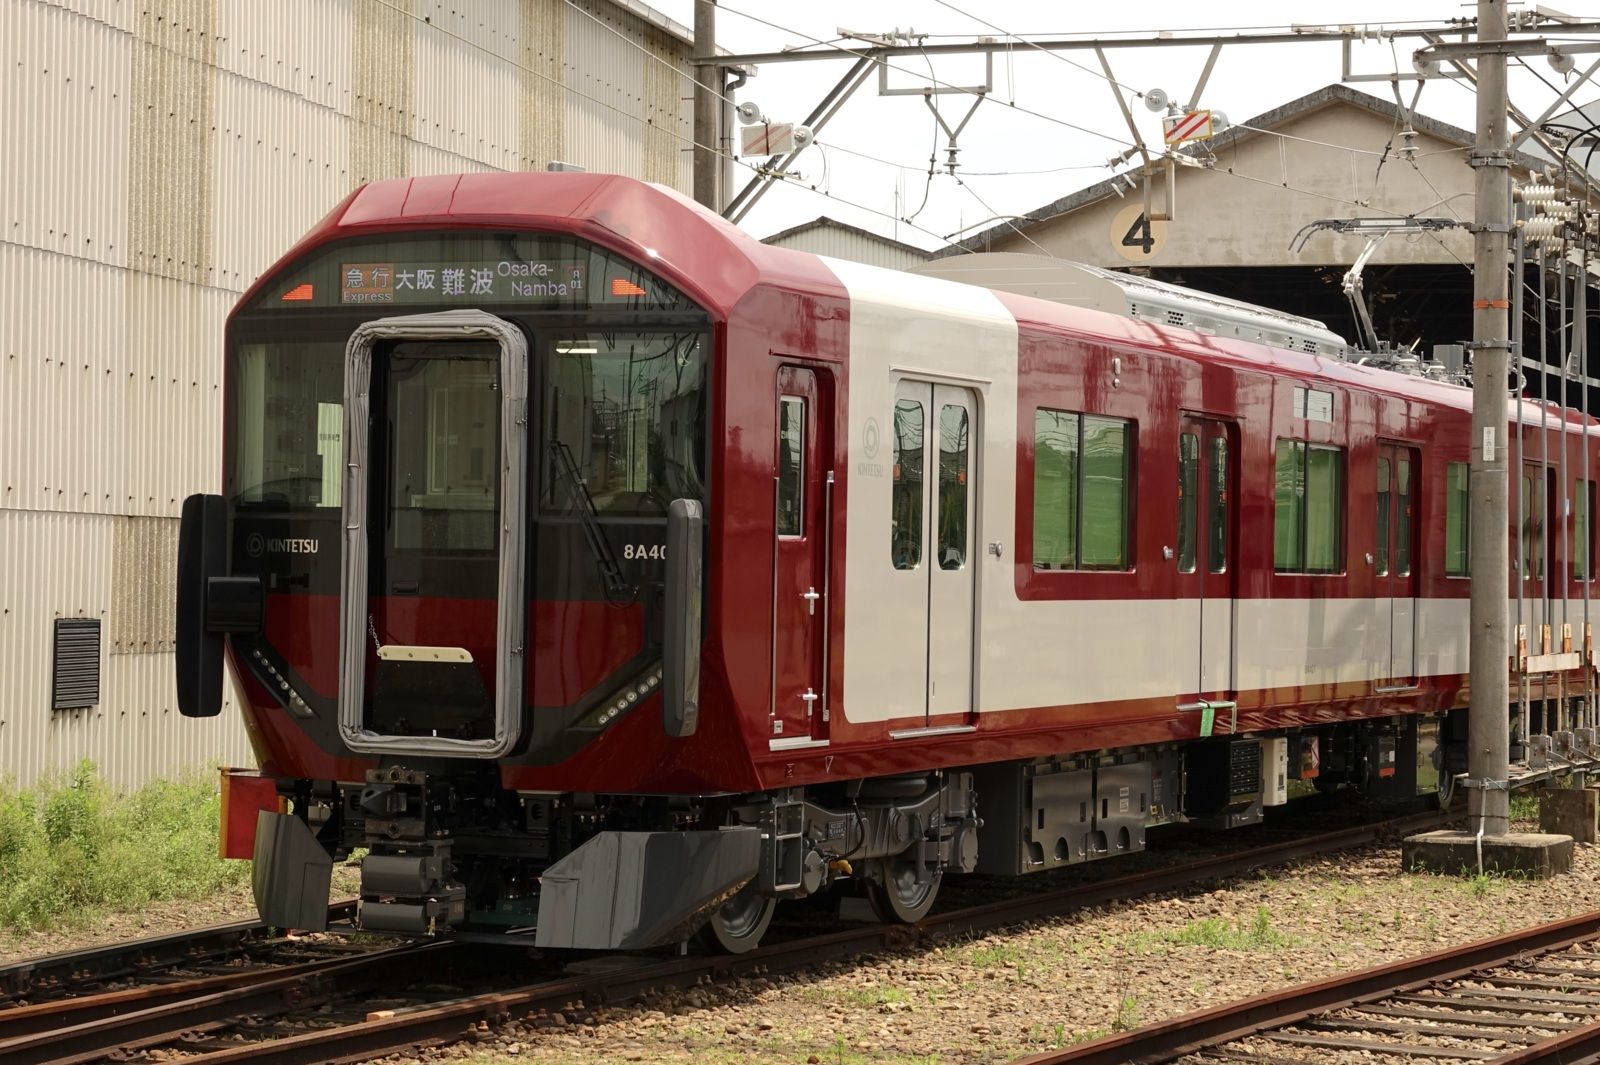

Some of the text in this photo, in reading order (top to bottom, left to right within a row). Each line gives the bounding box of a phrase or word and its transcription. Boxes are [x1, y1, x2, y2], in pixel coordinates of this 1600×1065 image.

[1122, 211, 1155, 254] 4
[497, 261, 554, 277] Osaka-
[346, 267, 390, 288] 急行
[395, 268, 493, 296] 大阪難波
[570, 280, 582, 289] 01
[511, 280, 568, 297] Namba
[343, 291, 392, 304] Express
[857, 463, 884, 478] KINTETSU
[266, 539, 319, 554] KINTETSU
